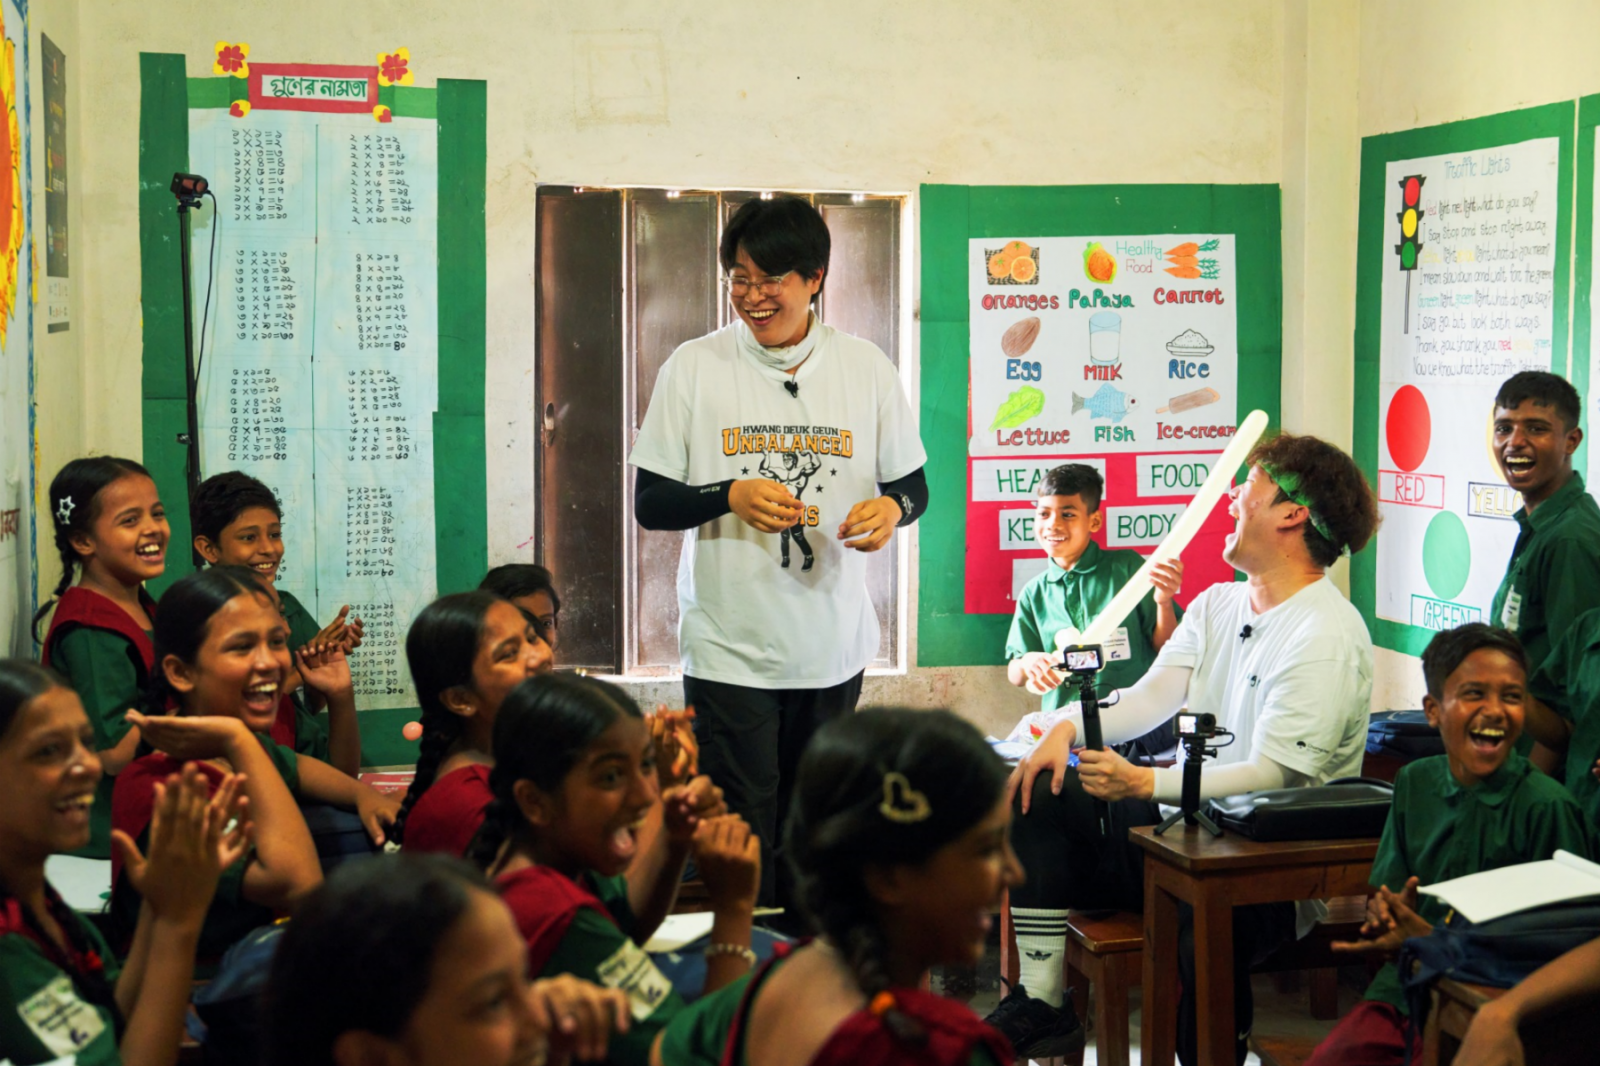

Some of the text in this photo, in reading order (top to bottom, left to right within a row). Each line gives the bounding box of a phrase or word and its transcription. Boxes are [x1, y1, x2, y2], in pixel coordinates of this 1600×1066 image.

[1126, 259, 1153, 274] Food
[1006, 358, 1042, 382] Egg
[1168, 359, 1210, 380] Rice
[743, 425, 839, 436] HWANG DEUK GEUN
[996, 429, 1071, 446] Lettuce
[1151, 463, 1209, 488] FOOD
[1394, 474, 1425, 502] RED
[1472, 486, 1524, 516] YELLO
[1117, 513, 1177, 539] BODY
